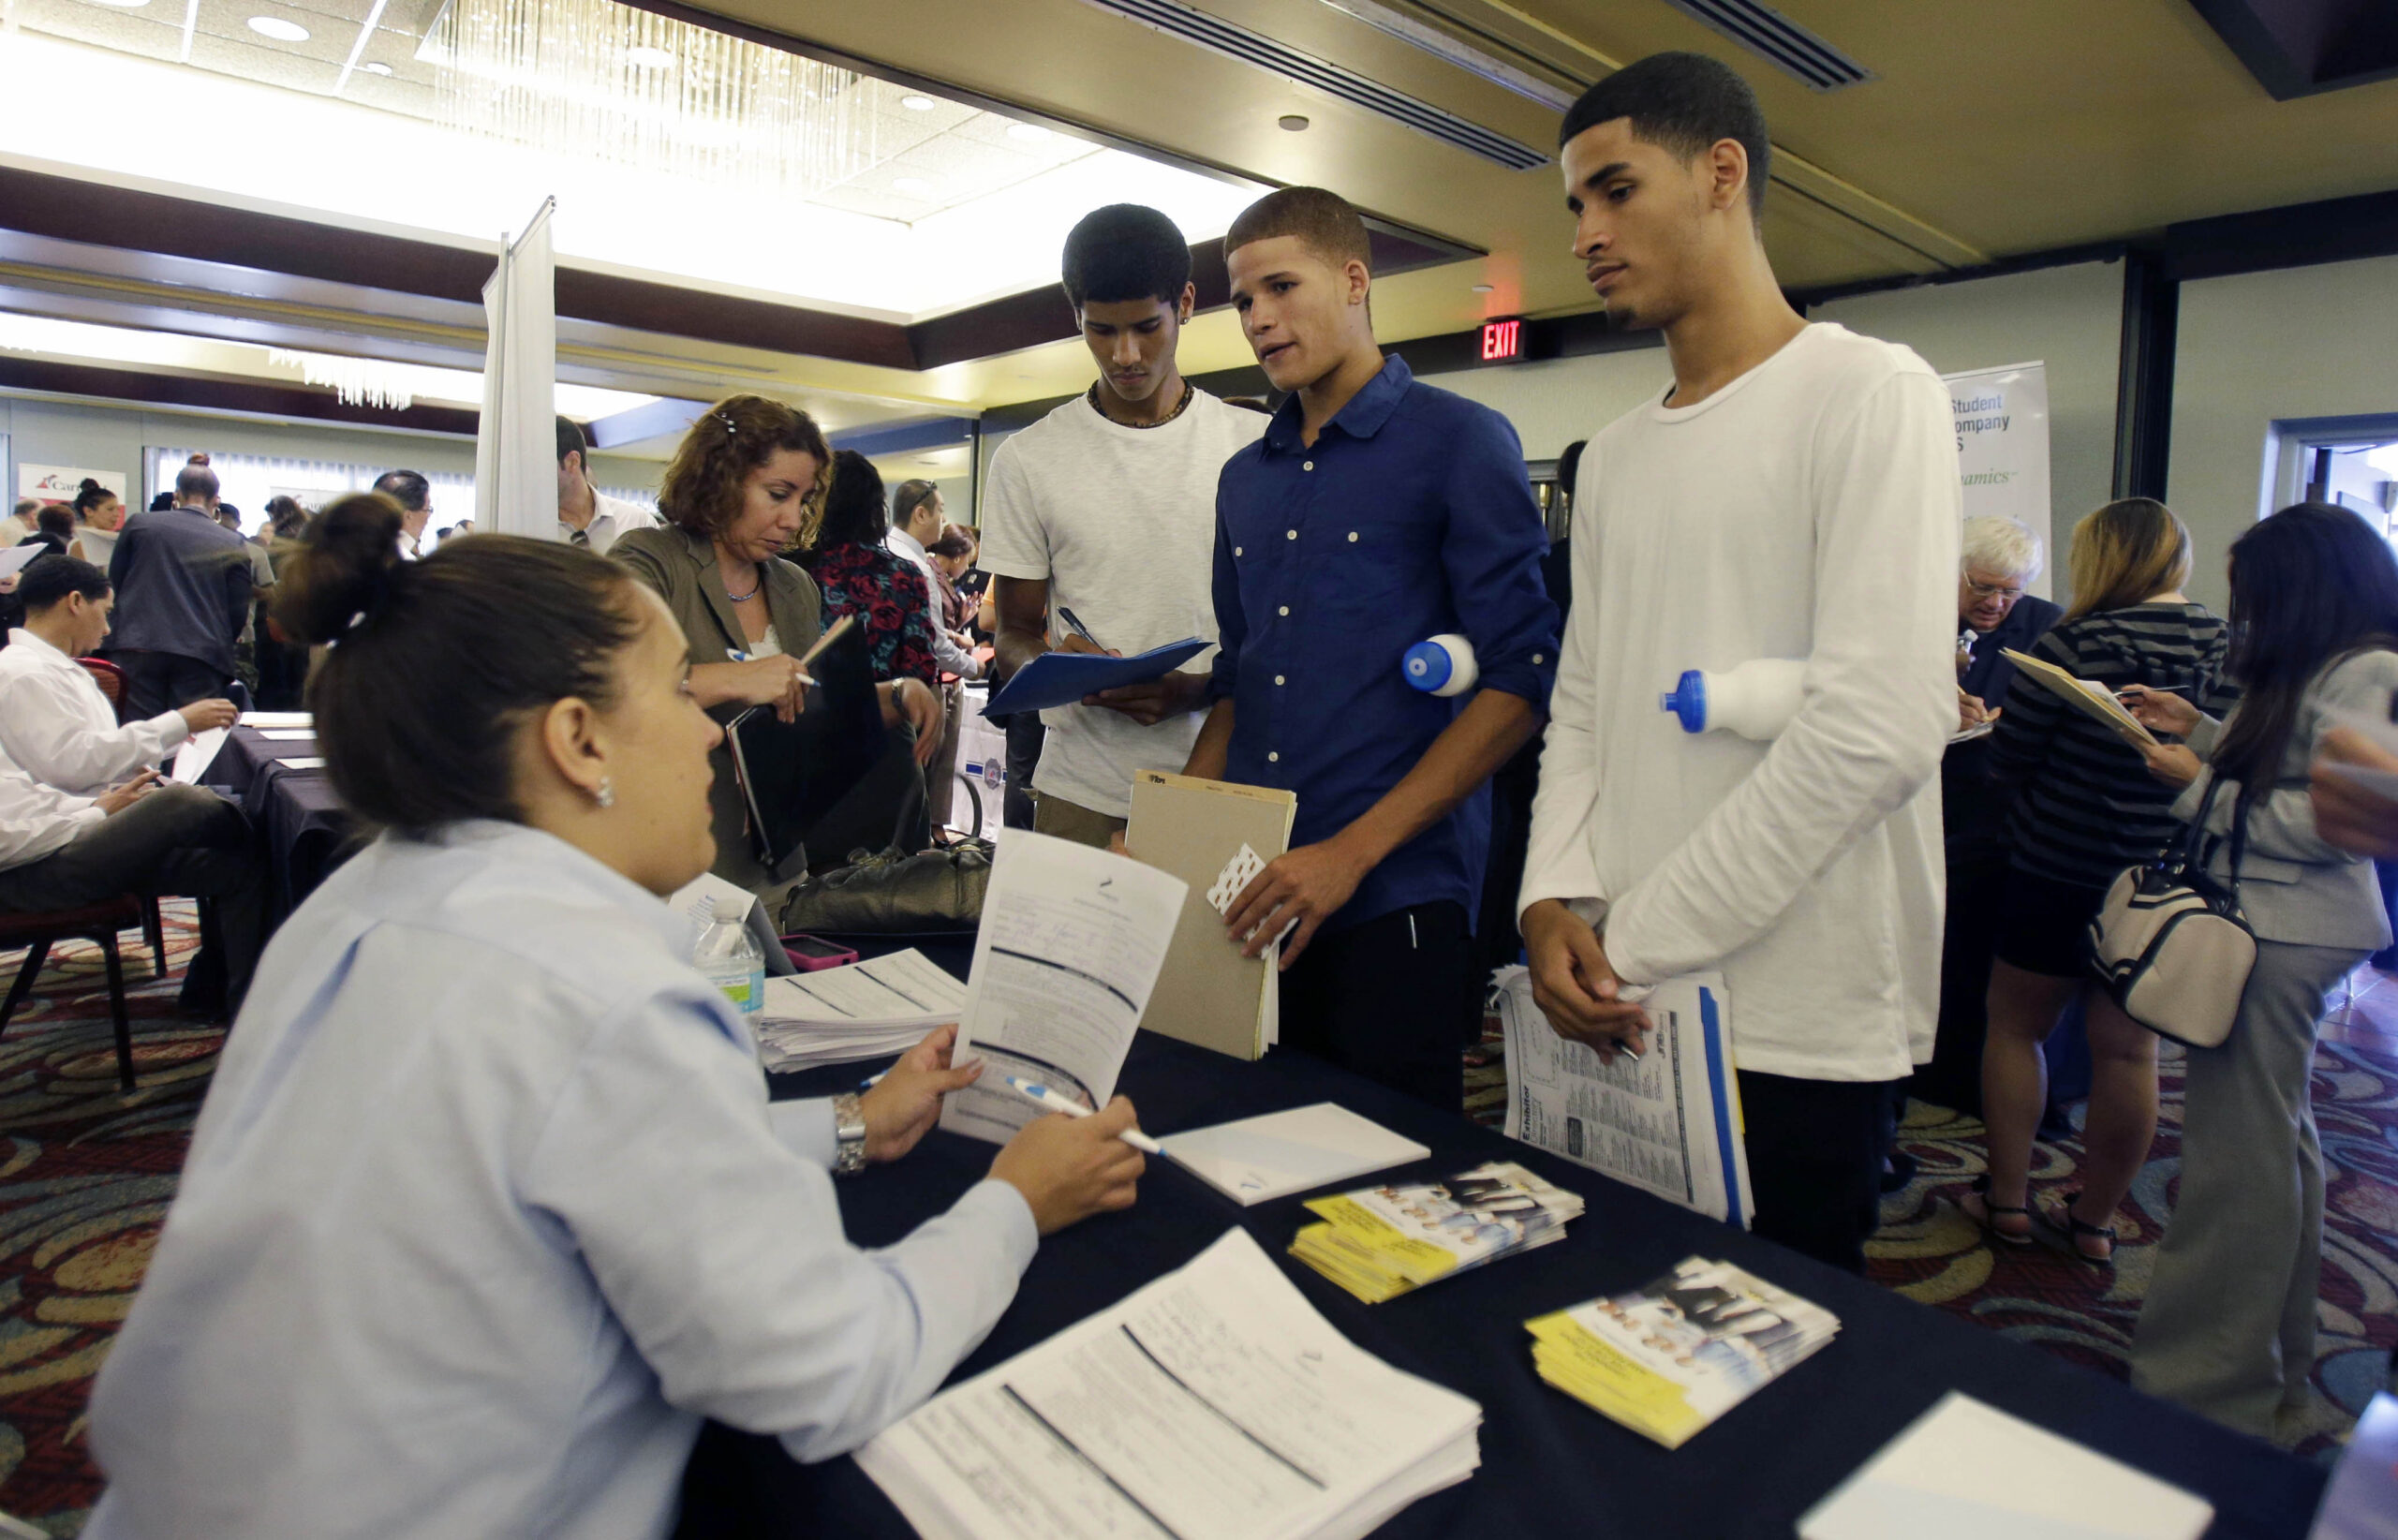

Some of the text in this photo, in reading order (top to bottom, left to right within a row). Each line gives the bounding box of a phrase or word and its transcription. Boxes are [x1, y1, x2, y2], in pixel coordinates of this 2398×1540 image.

[1483, 320, 1519, 361] EXIT
[1955, 415, 2009, 434] ompany
[1961, 468, 2009, 486] amics
